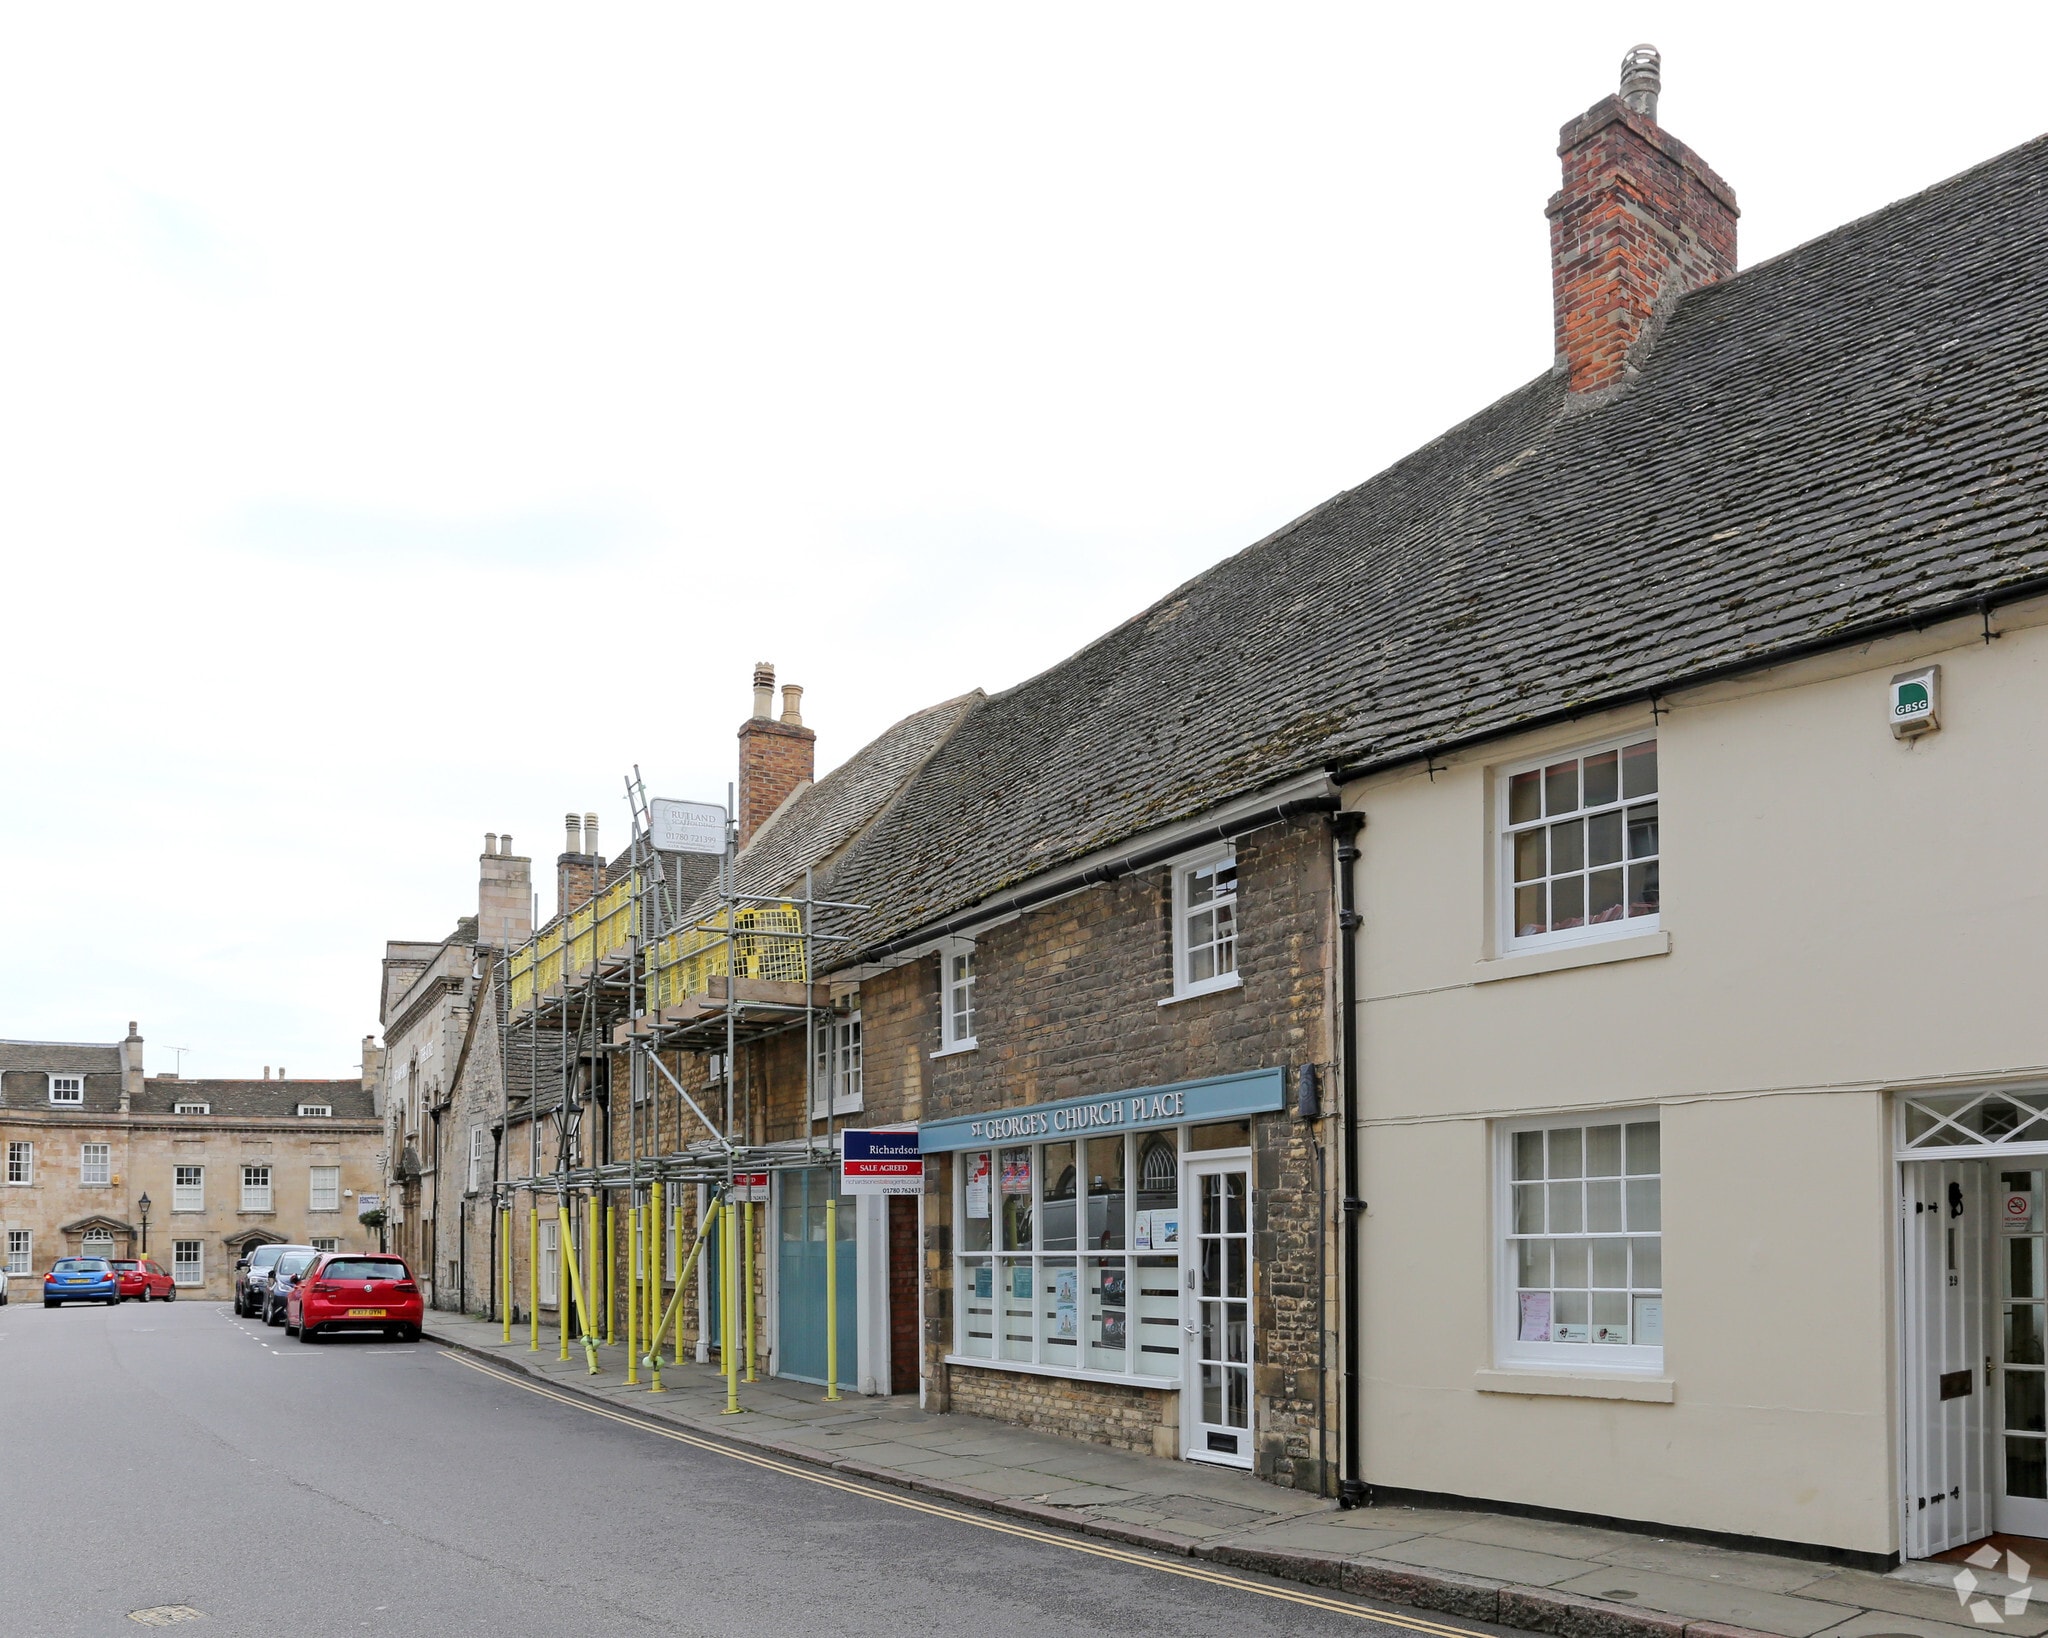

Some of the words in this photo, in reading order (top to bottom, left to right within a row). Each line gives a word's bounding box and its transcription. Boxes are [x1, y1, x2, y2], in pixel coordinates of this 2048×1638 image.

[1896, 699, 1927, 715] GBSG
[672, 811, 716, 822] RUTLAND
[672, 820, 715, 828] SCAFFOLDING
[666, 832, 688, 841] 01780
[690, 835, 716, 843] 721399
[985, 1112, 1048, 1140] GEORGE'S
[1054, 1101, 1124, 1131] CHURCH
[1132, 1091, 1185, 1120] PLACE
[869, 1144, 919, 1155] Richardson
[859, 1164, 877, 1172] SALE
[879, 1164, 908, 1172] AGREED
[1949, 1275, 1958, 1287] 29
